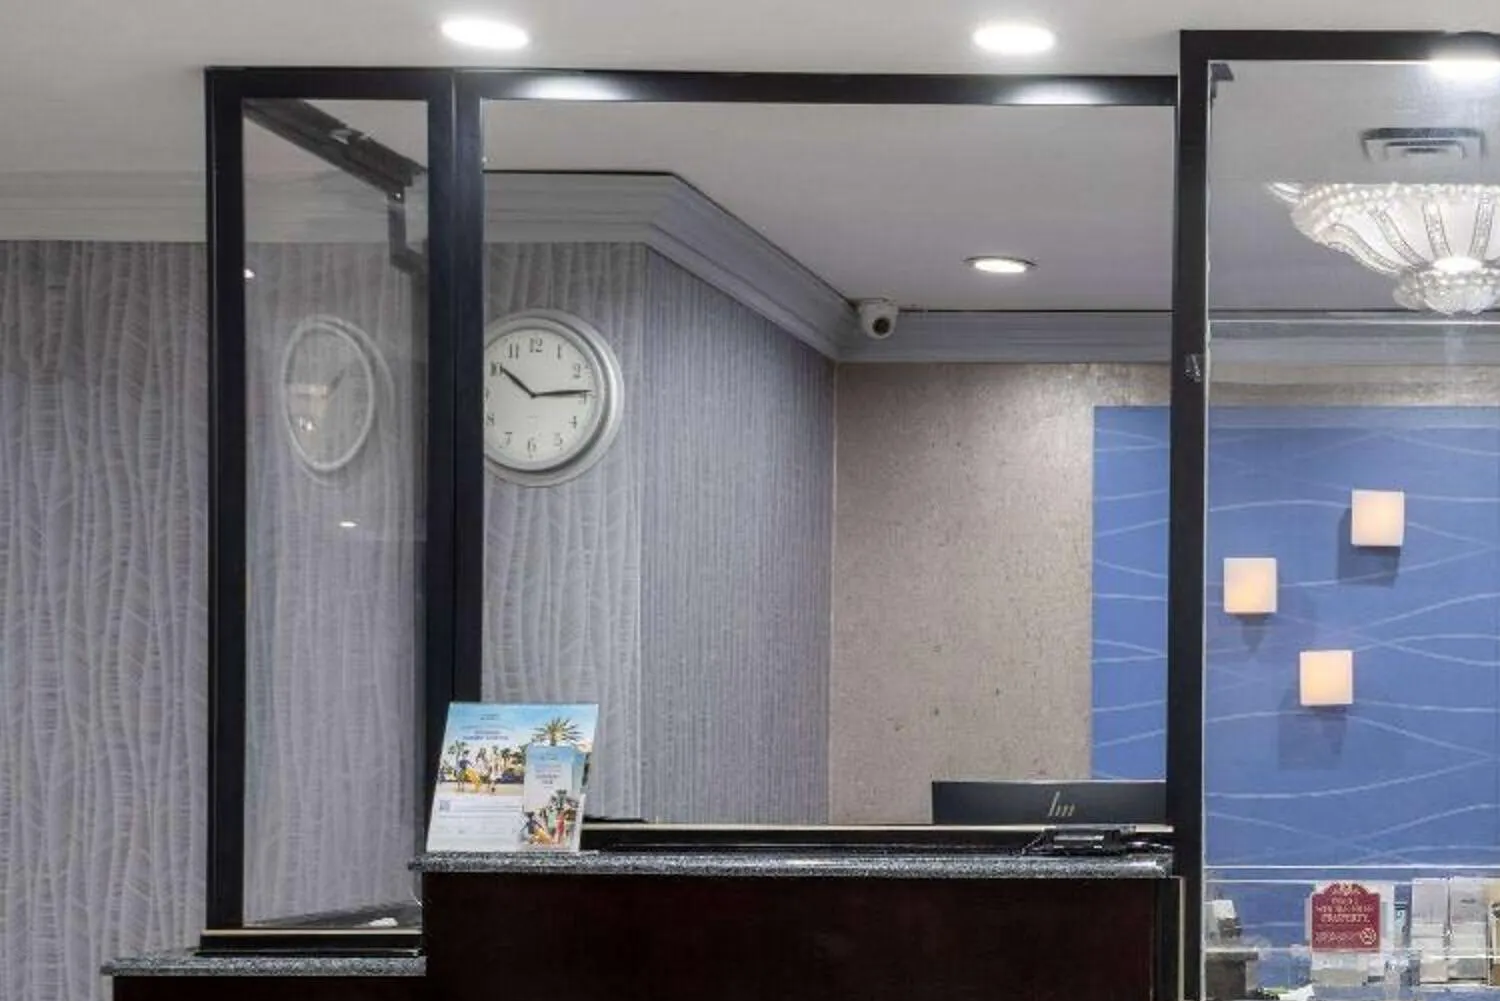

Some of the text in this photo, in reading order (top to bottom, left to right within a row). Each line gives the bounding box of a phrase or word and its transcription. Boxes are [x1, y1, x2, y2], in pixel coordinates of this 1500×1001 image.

[508, 343, 519, 360] 11
[529, 338, 544, 353] 12
[556, 343, 562, 360] 1
[573, 363, 582, 379] 2
[568, 415, 578, 429] 4
